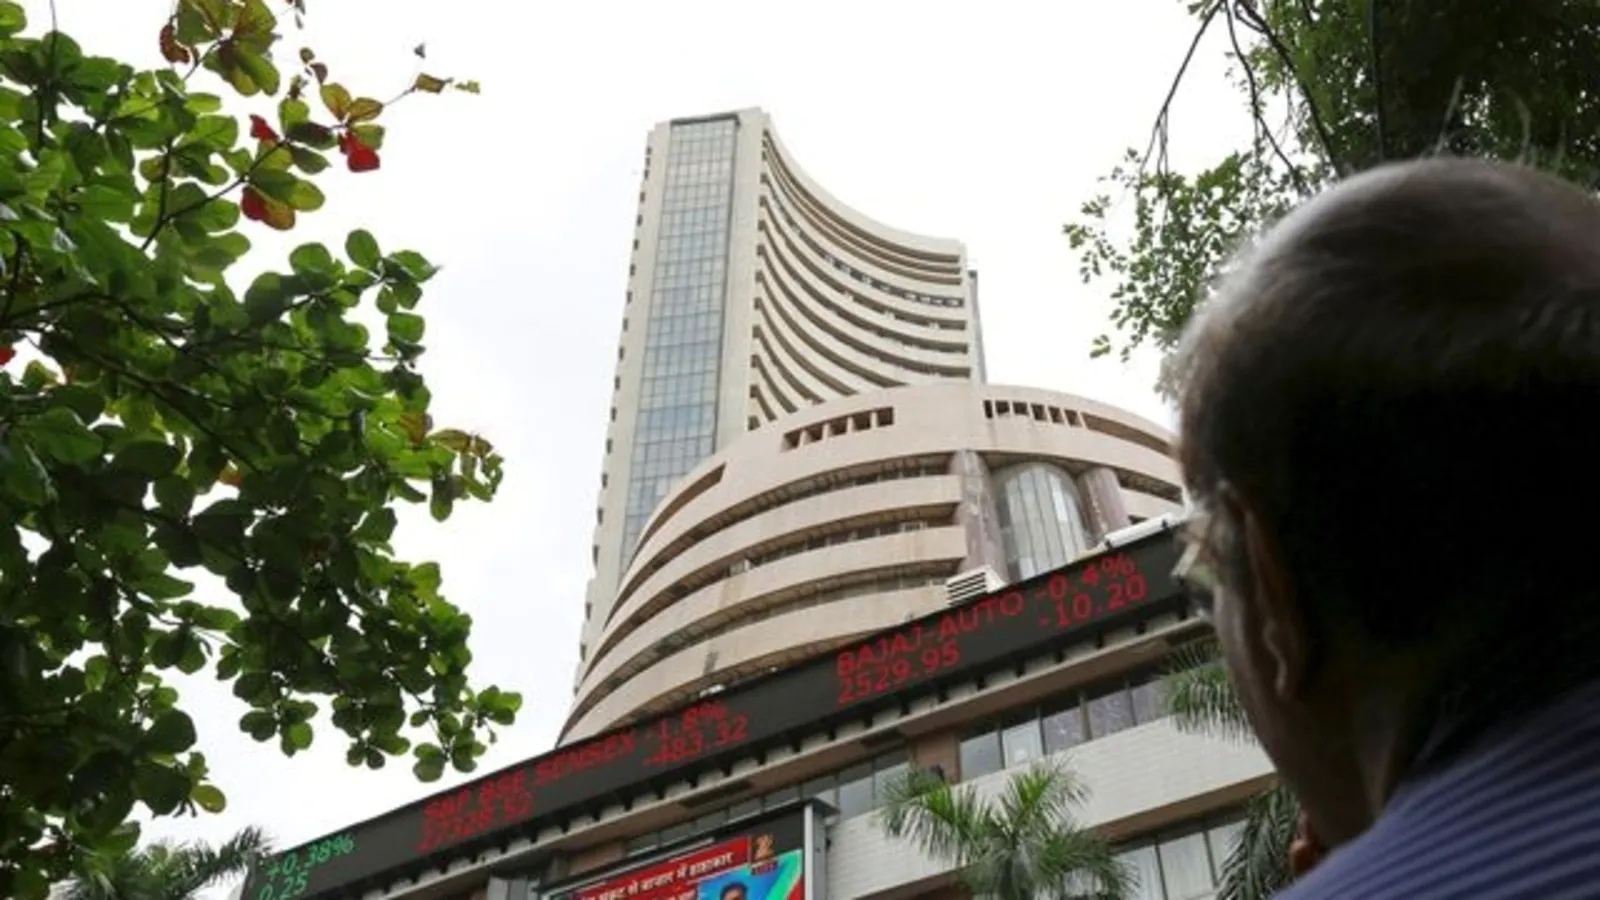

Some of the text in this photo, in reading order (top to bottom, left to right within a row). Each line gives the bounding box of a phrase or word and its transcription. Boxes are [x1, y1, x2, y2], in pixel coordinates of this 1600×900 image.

[1036, 554, 1137, 598] -0.4%
[838, 574, 1147, 704] 2529.95 -10.20
